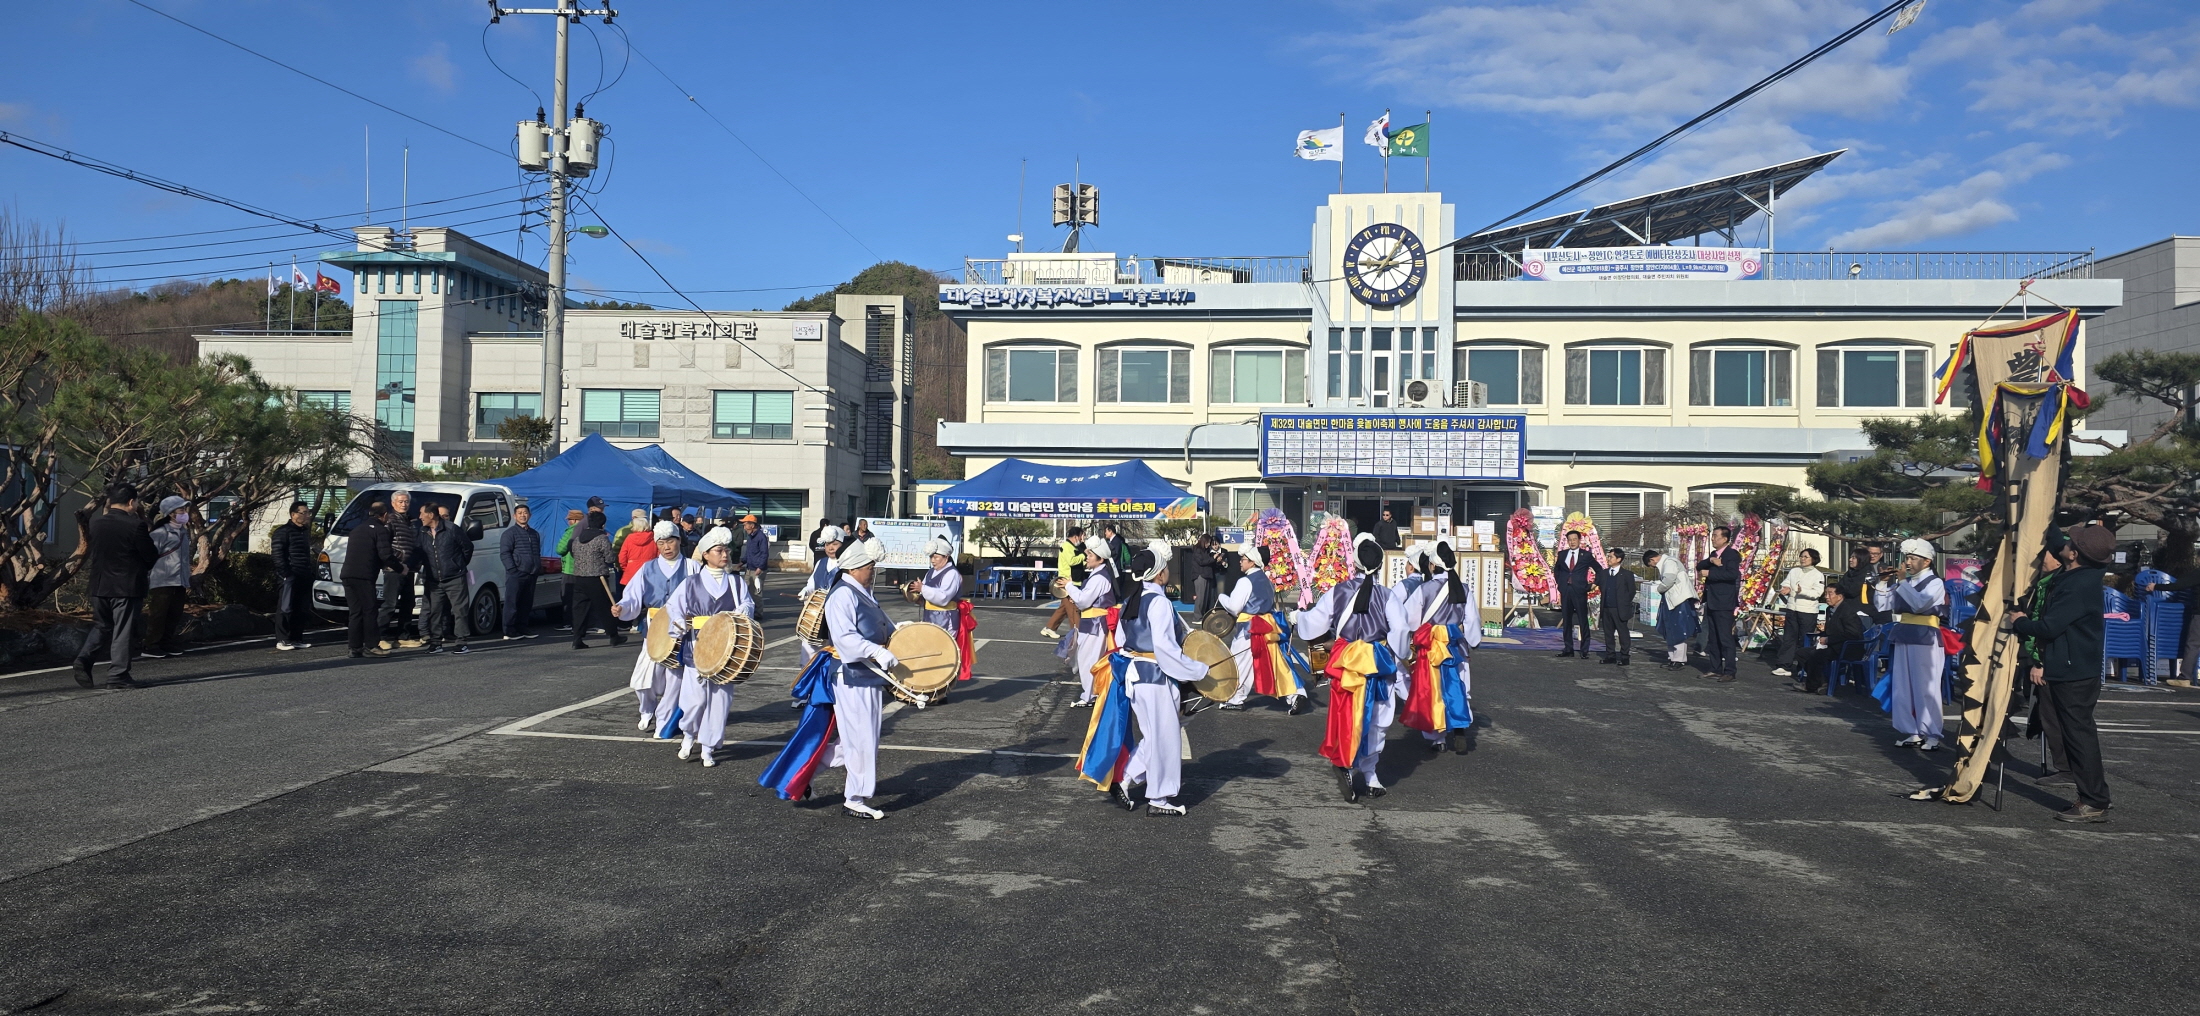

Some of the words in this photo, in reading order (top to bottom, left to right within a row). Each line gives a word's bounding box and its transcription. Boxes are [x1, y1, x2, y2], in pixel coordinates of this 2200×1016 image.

[1615, 249, 1644, 260] 연결도로
[1645, 249, 1696, 260] 예비타당성조사
[1697, 250, 1725, 260] 대상사업
[1728, 251, 1741, 261] 선정
[1532, 264, 1539, 272] 경
[946, 287, 1111, 306] 대술면행정복지센터
[1122, 288, 1162, 304] 대술로
[1165, 288, 1189, 302] 147
[619, 320, 758, 340] 대술면복지회관
[1271, 418, 1295, 430] 제32회
[1297, 418, 1328, 430] 대술면민
[1331, 418, 1354, 430] 한마음
[1357, 418, 1396, 430] 윷놀이축제
[1398, 418, 1422, 430] 행사에
[1425, 418, 1448, 430] 도움을
[1451, 418, 1475, 430] 주셔서
[1477, 418, 1517, 430] 감사합니다
[1021, 470, 1117, 484] 대술면체육회
[966, 501, 1004, 512] 제32회
[1008, 501, 1054, 513] 대술면민
[1057, 502, 1094, 513] 한마음
[1097, 502, 1156, 513] 윷놀이축제
[1222, 533, 1230, 543] P
